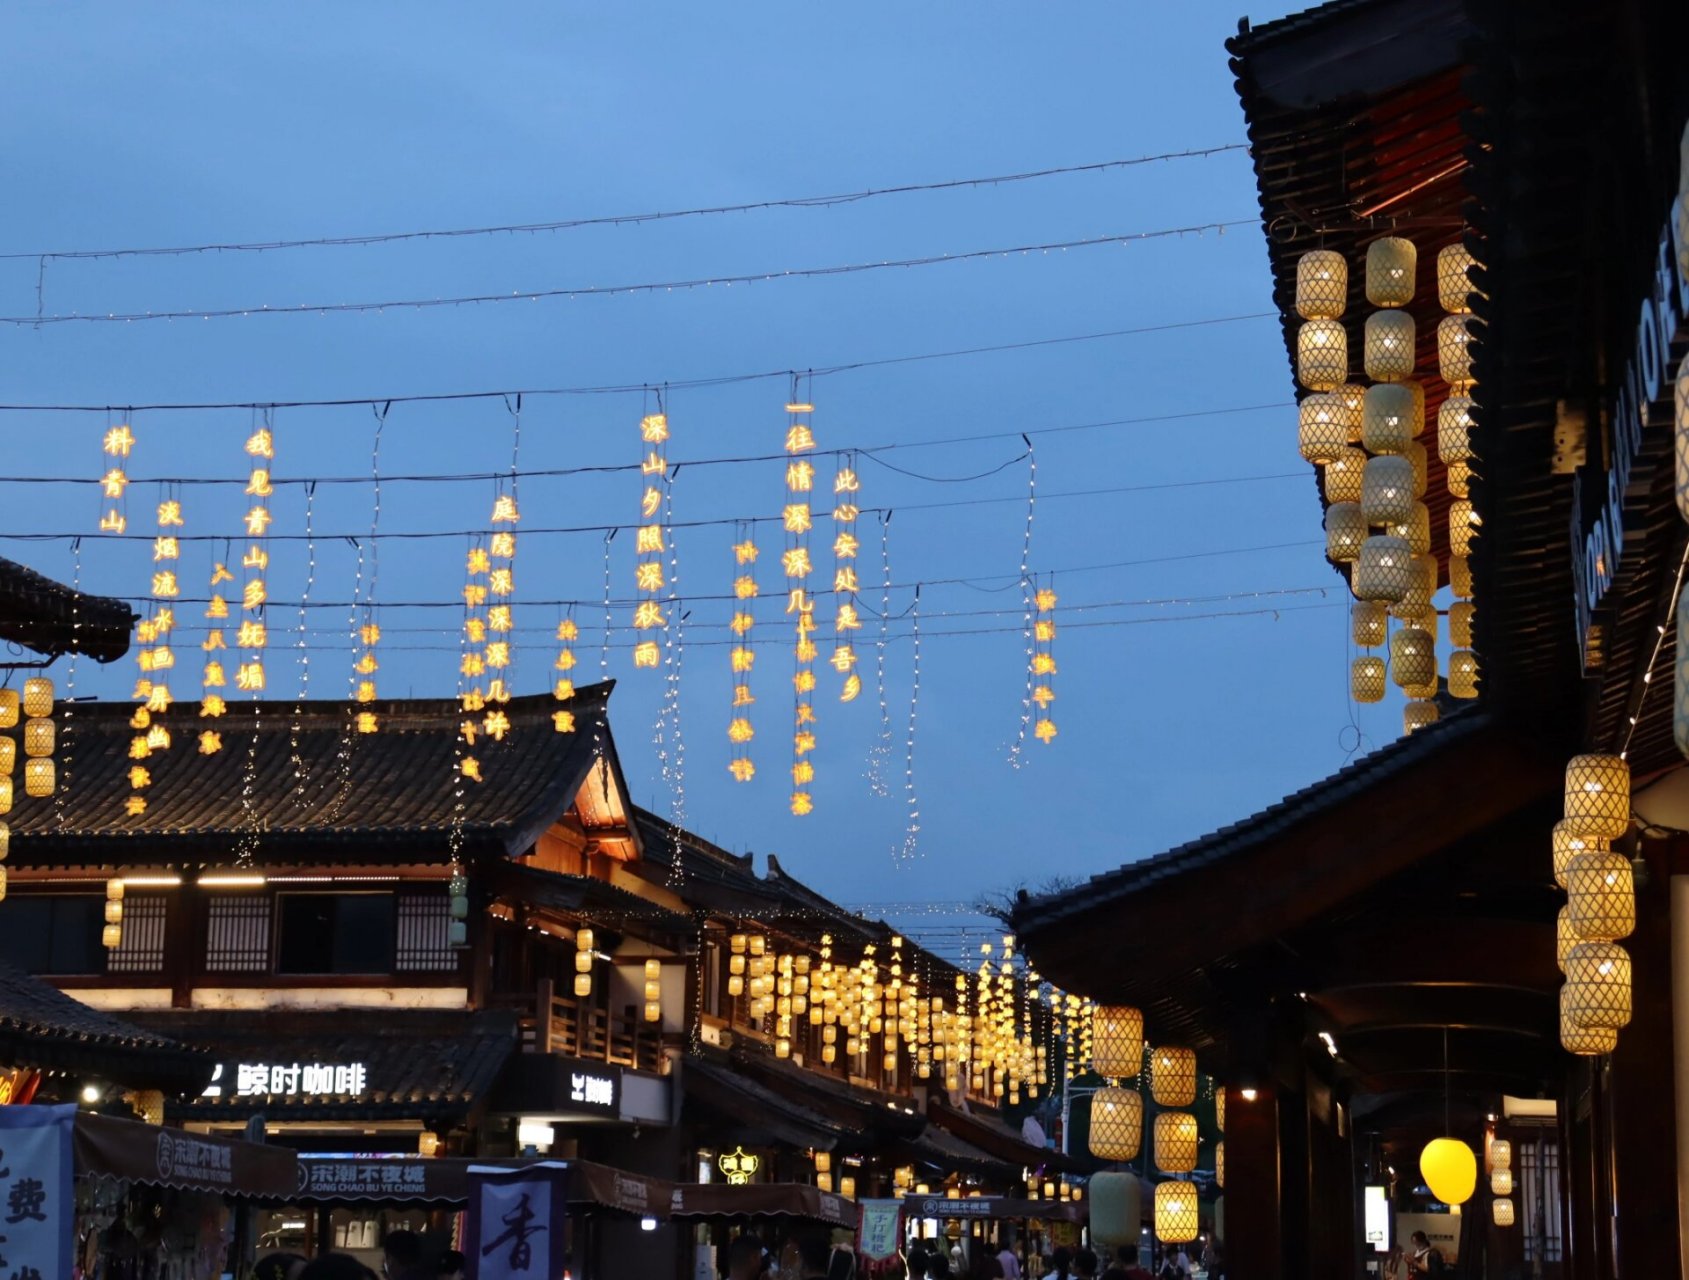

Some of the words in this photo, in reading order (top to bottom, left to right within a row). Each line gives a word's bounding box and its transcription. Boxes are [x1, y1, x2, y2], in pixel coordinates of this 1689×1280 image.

[100, 425, 136, 534] 料青山
[233, 429, 274, 691] 我见青山多妩媚
[635, 414, 670, 668] 深山夕照深秋雨
[782, 403, 816, 650] 一往情深深几
[830, 467, 862, 703] 此心安处是吾乡
[146, 500, 184, 750] 淡烟流水画屏幽
[483, 496, 520, 743] 庭院深深深几许
[237, 1063, 367, 1096] 鲸时咖啡
[311, 1164, 426, 1183] 宋潮不夜城
[311, 1183, 337, 1192] SONG
[338, 1183, 364, 1193] CHAO
[366, 1183, 380, 1193] BU
[381, 1183, 393, 1193] YE
[394, 1183, 426, 1193] CHENG
[481, 1192, 548, 1271] 香
